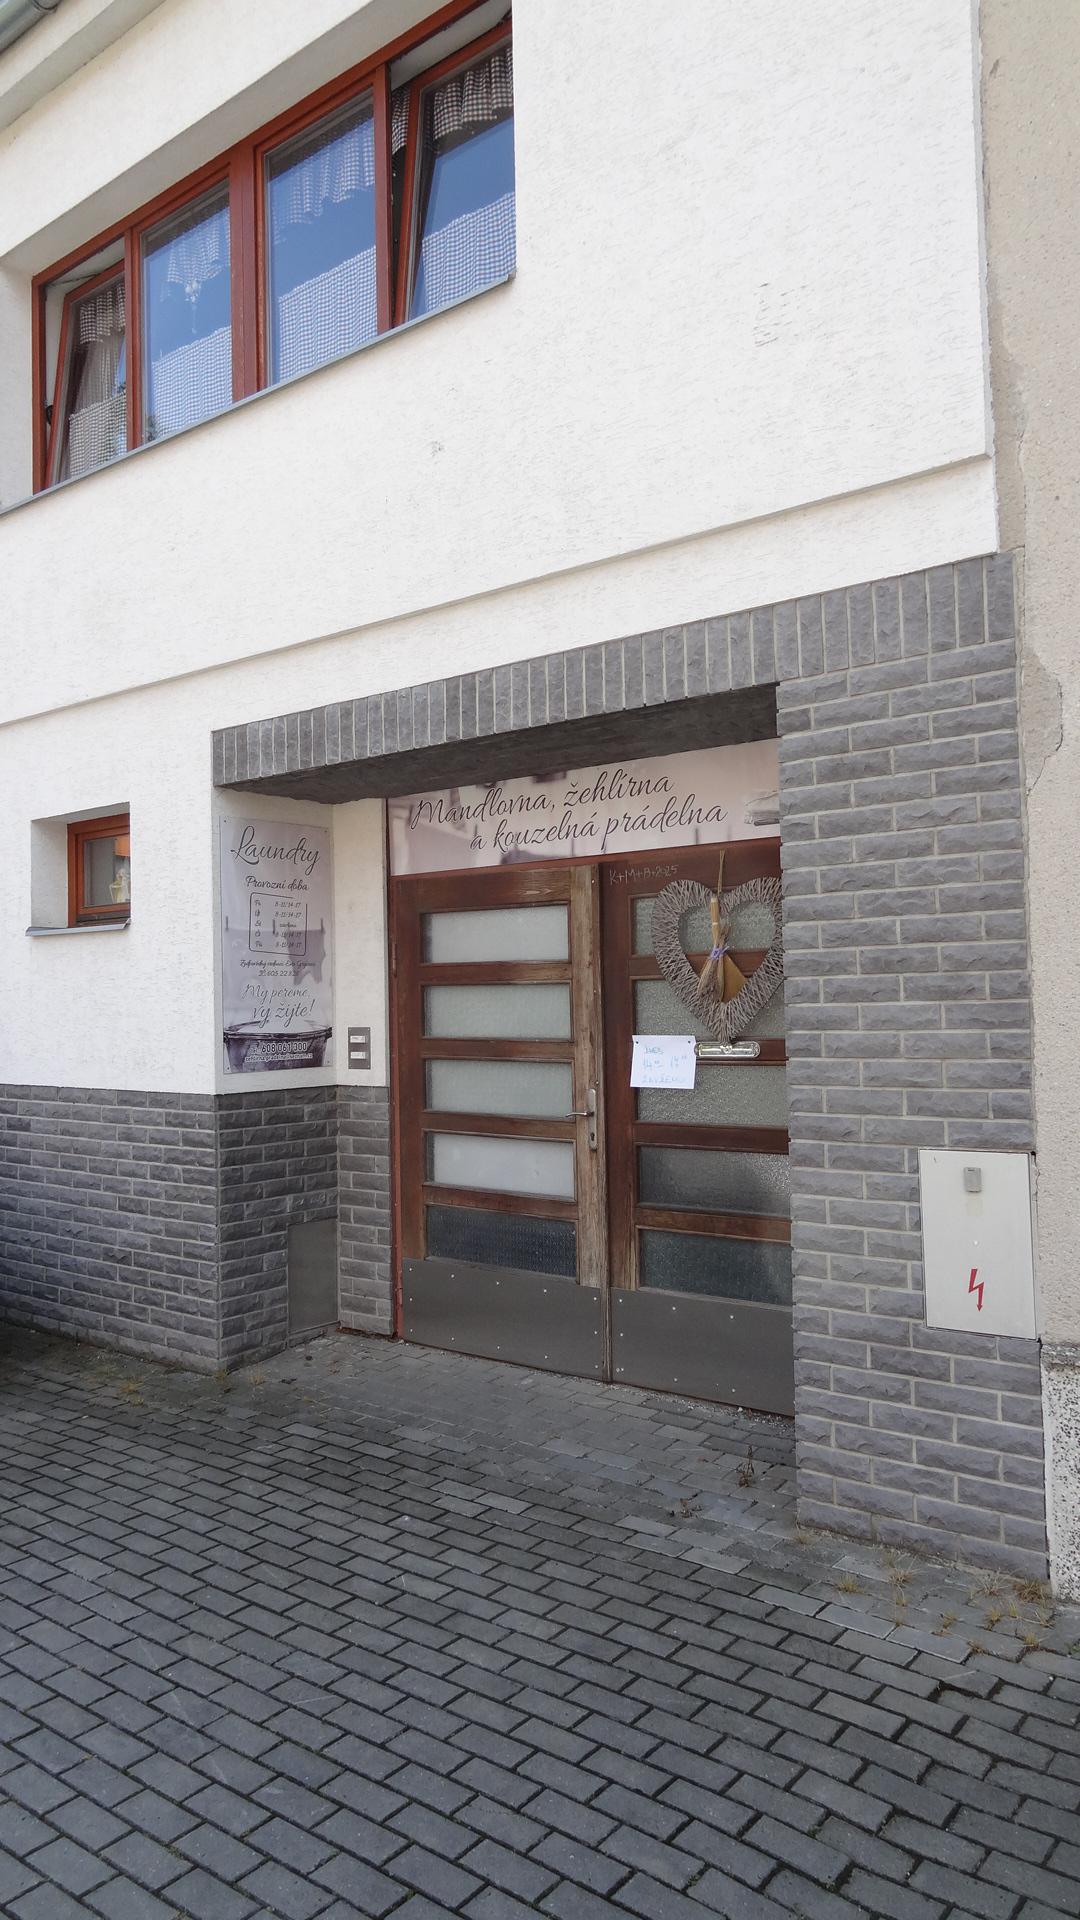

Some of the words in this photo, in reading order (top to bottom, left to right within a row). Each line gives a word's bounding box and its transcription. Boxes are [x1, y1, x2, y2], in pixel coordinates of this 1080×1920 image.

[410, 787, 556, 830] Mandlovna,
[563, 768, 675, 807] žehlírna
[470, 835, 488, 850] a
[493, 810, 600, 853] kouzelná
[601, 793, 729, 850] prádelna
[230, 825, 320, 876] Laundry
[245, 875, 285, 890] Provozní
[287, 878, 308, 891] doba
[241, 983, 269, 1004] My
[275, 999, 315, 1028] žijte!
